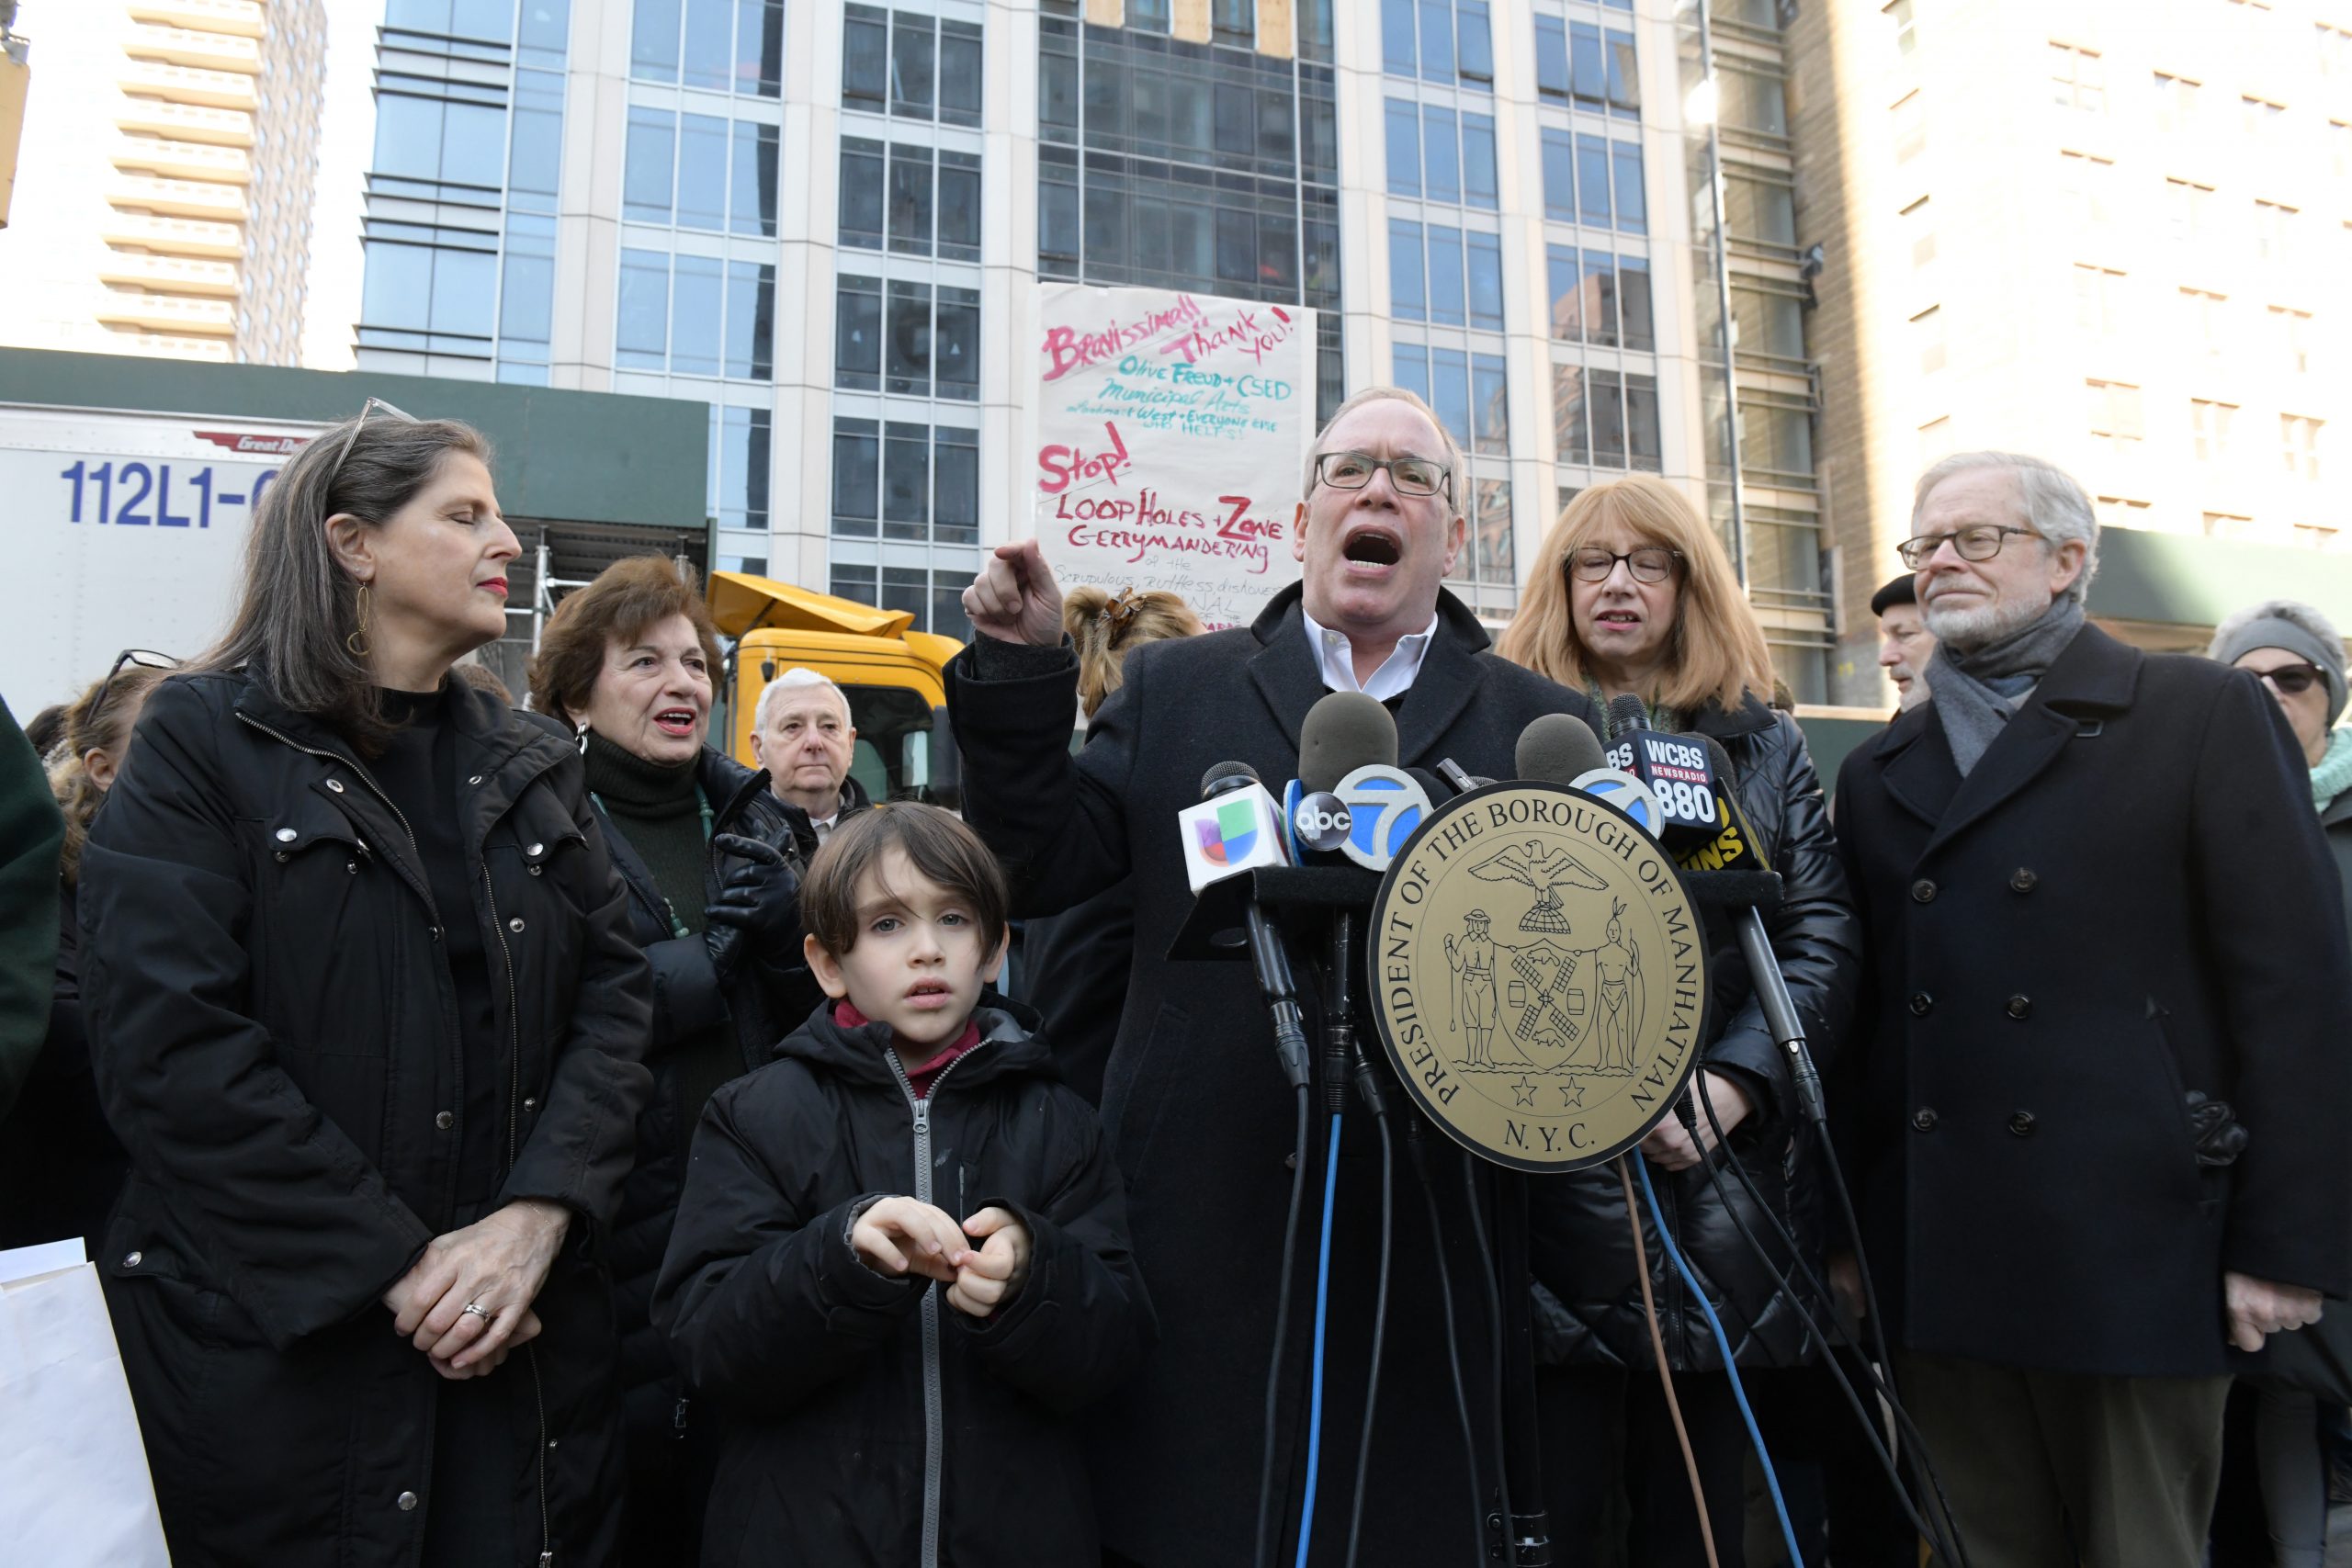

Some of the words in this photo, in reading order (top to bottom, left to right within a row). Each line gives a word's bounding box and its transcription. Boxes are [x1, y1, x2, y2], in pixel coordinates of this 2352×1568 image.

[1237, 374, 1292, 400] CSED
[237, 435, 280, 452] Great
[1645, 739, 1705, 770] WCBS
[1651, 765, 1706, 783] NEWSRADIO
[1295, 805, 1351, 831] abc
[1653, 778, 1716, 824] 880
[1426, 811, 1484, 863] THE
[1486, 798, 1639, 862] BOROUGH
[1680, 827, 1744, 871] INS
[1400, 860, 1430, 906] OF
[1638, 859, 1674, 897] OF
[1386, 911, 1461, 1107] PRESIDENT
[1629, 904, 1698, 1113] MANHATTAN
